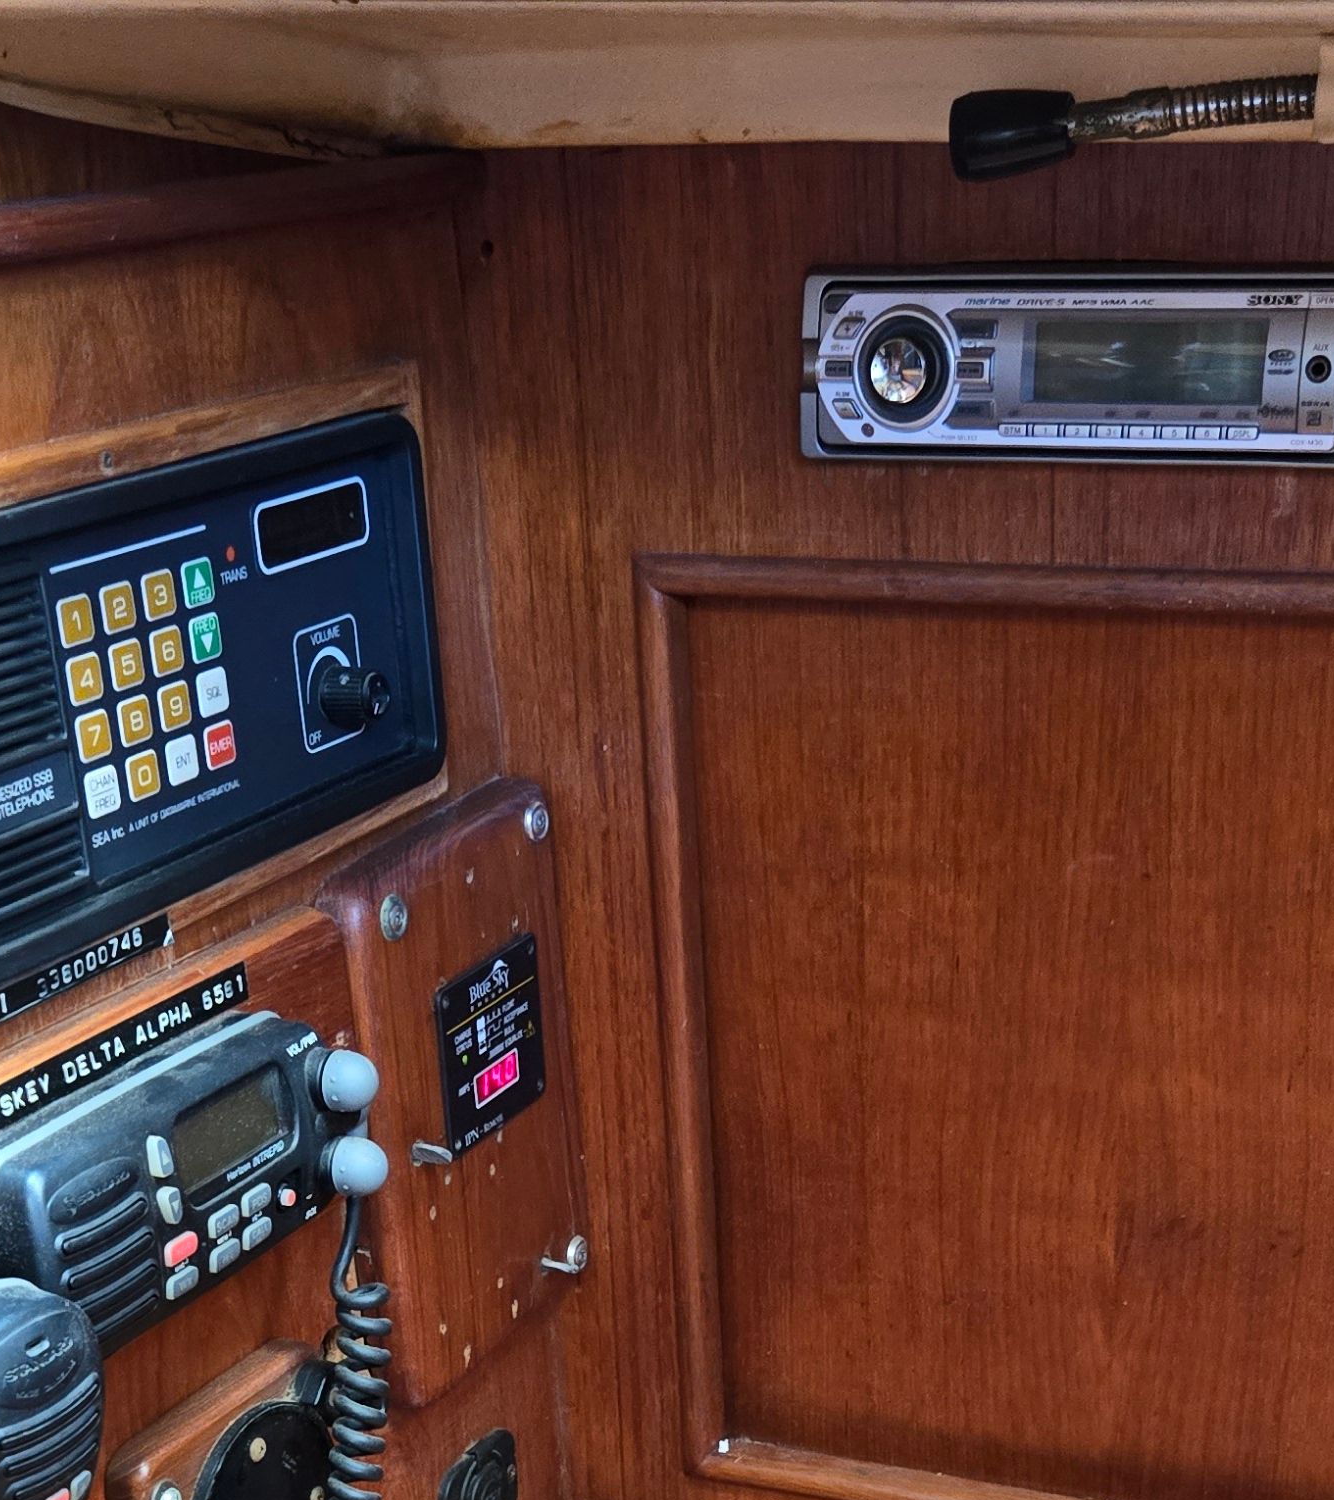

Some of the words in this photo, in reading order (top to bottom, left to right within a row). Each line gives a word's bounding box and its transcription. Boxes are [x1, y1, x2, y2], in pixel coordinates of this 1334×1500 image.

[964, 298, 1011, 306] marine
[1247, 294, 1304, 305] SONY
[219, 566, 248, 586] TRANS
[154, 584, 167, 608] 3
[190, 587, 212, 604] FREQ
[113, 596, 127, 620] 2
[73, 610, 82, 632] 1
[194, 618, 216, 635] FREQ
[309, 625, 341, 647] VOLUME
[162, 641, 175, 663] 6
[120, 654, 135, 678] 5
[80, 667, 94, 690] 4
[169, 694, 182, 718] 9
[129, 709, 143, 732] 8
[87, 724, 102, 748] 7
[209, 736, 233, 756] EMER
[308, 730, 322, 746] OFF
[176, 751, 192, 769] ENT
[33, 767, 54, 788] SSB
[89, 772, 116, 792] CHAN
[137, 764, 151, 788] 0
[95, 792, 117, 810] FREQ
[91, 828, 111, 848] SEA
[135, 816, 149, 831] UNIT
[150, 812, 159, 823] OF
[469, 976, 491, 1005] Blue
[492, 968, 509, 989] Sky
[62, 1036, 126, 1085] DELTA
[135, 1001, 193, 1046] ALPHA
[465, 1127, 480, 1147] IPN
[226, 1161, 252, 1182] Horizon
[253, 1139, 285, 1167] INTREPID
